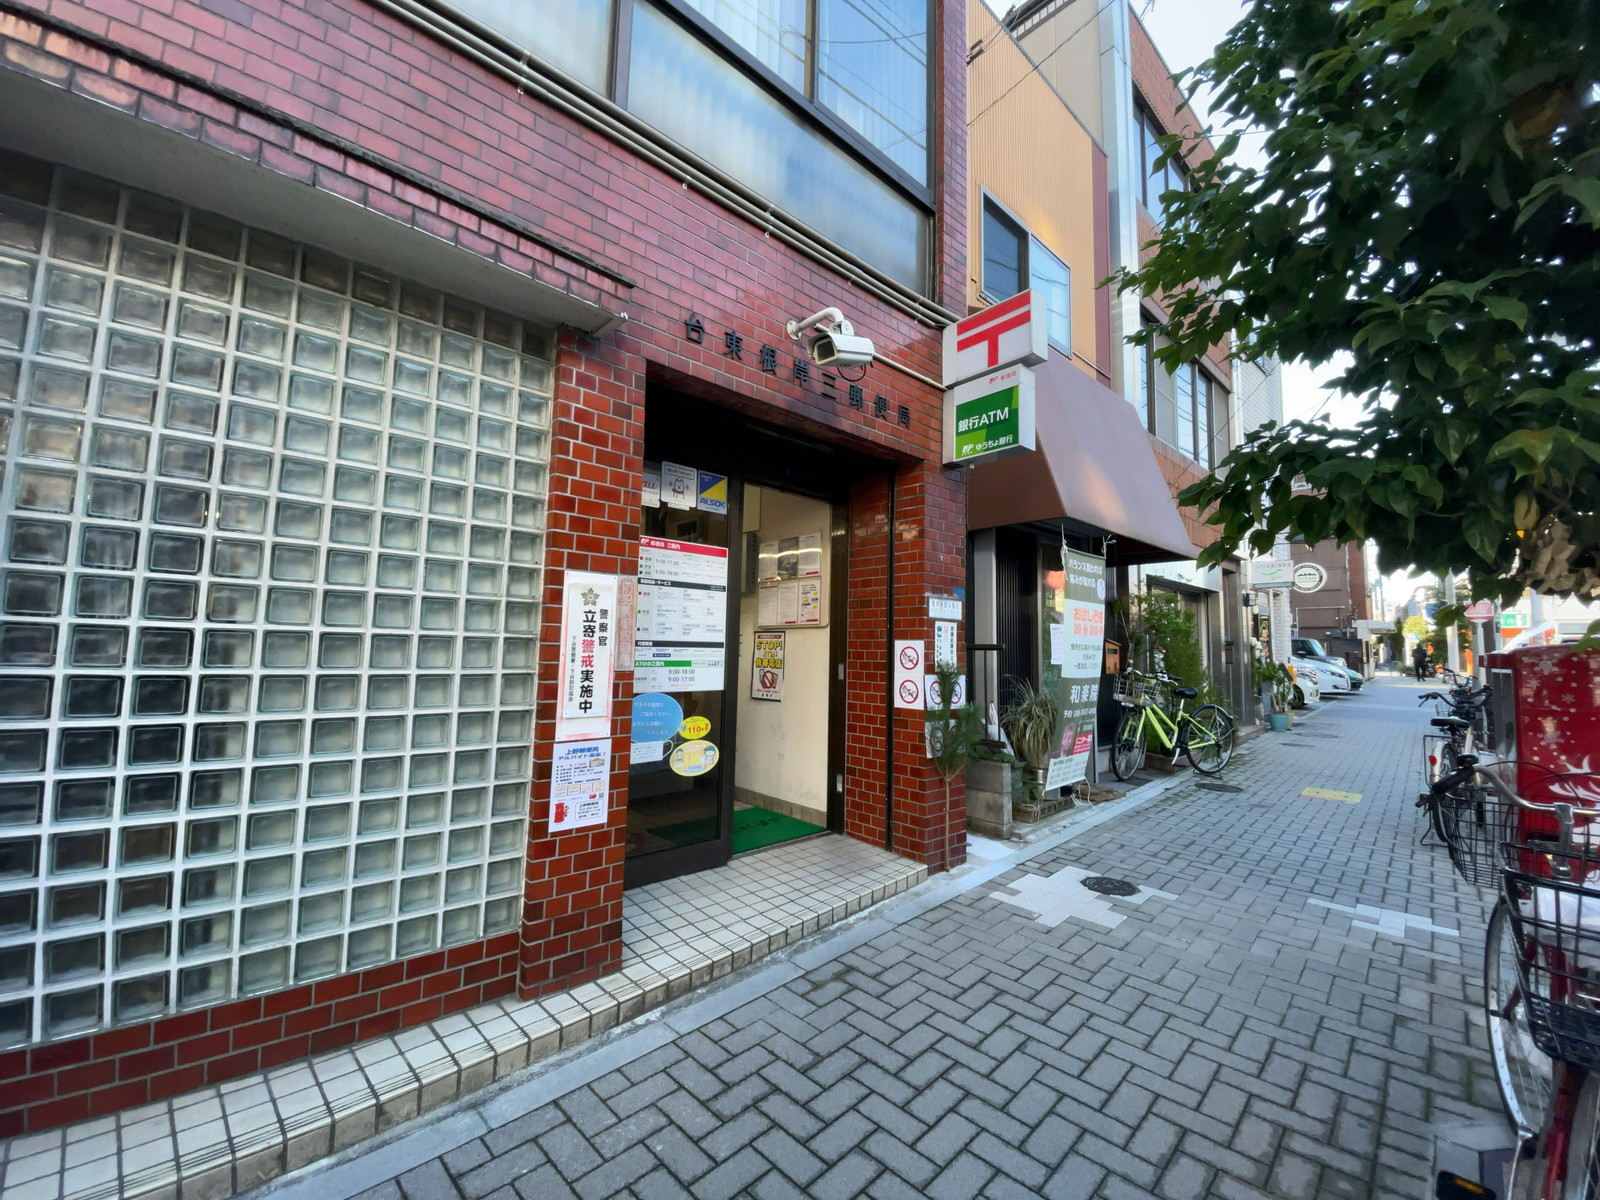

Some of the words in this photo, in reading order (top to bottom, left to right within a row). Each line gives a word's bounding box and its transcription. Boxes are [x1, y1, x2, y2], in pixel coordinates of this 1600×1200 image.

[684, 312, 911, 428] 台東根岸三郵便局
[957, 407, 1010, 433] 銀行ATM
[975, 434, 1014, 451] ゆうちょ銀行
[699, 498, 725, 508] ALSOK
[598, 608, 609, 646] 警察官
[756, 640, 783, 651] STOP!
[578, 609, 597, 714] 立寄警戒実施中
[1069, 684, 1098, 704] 和楽院
[565, 746, 600, 756] 上野郵便局
